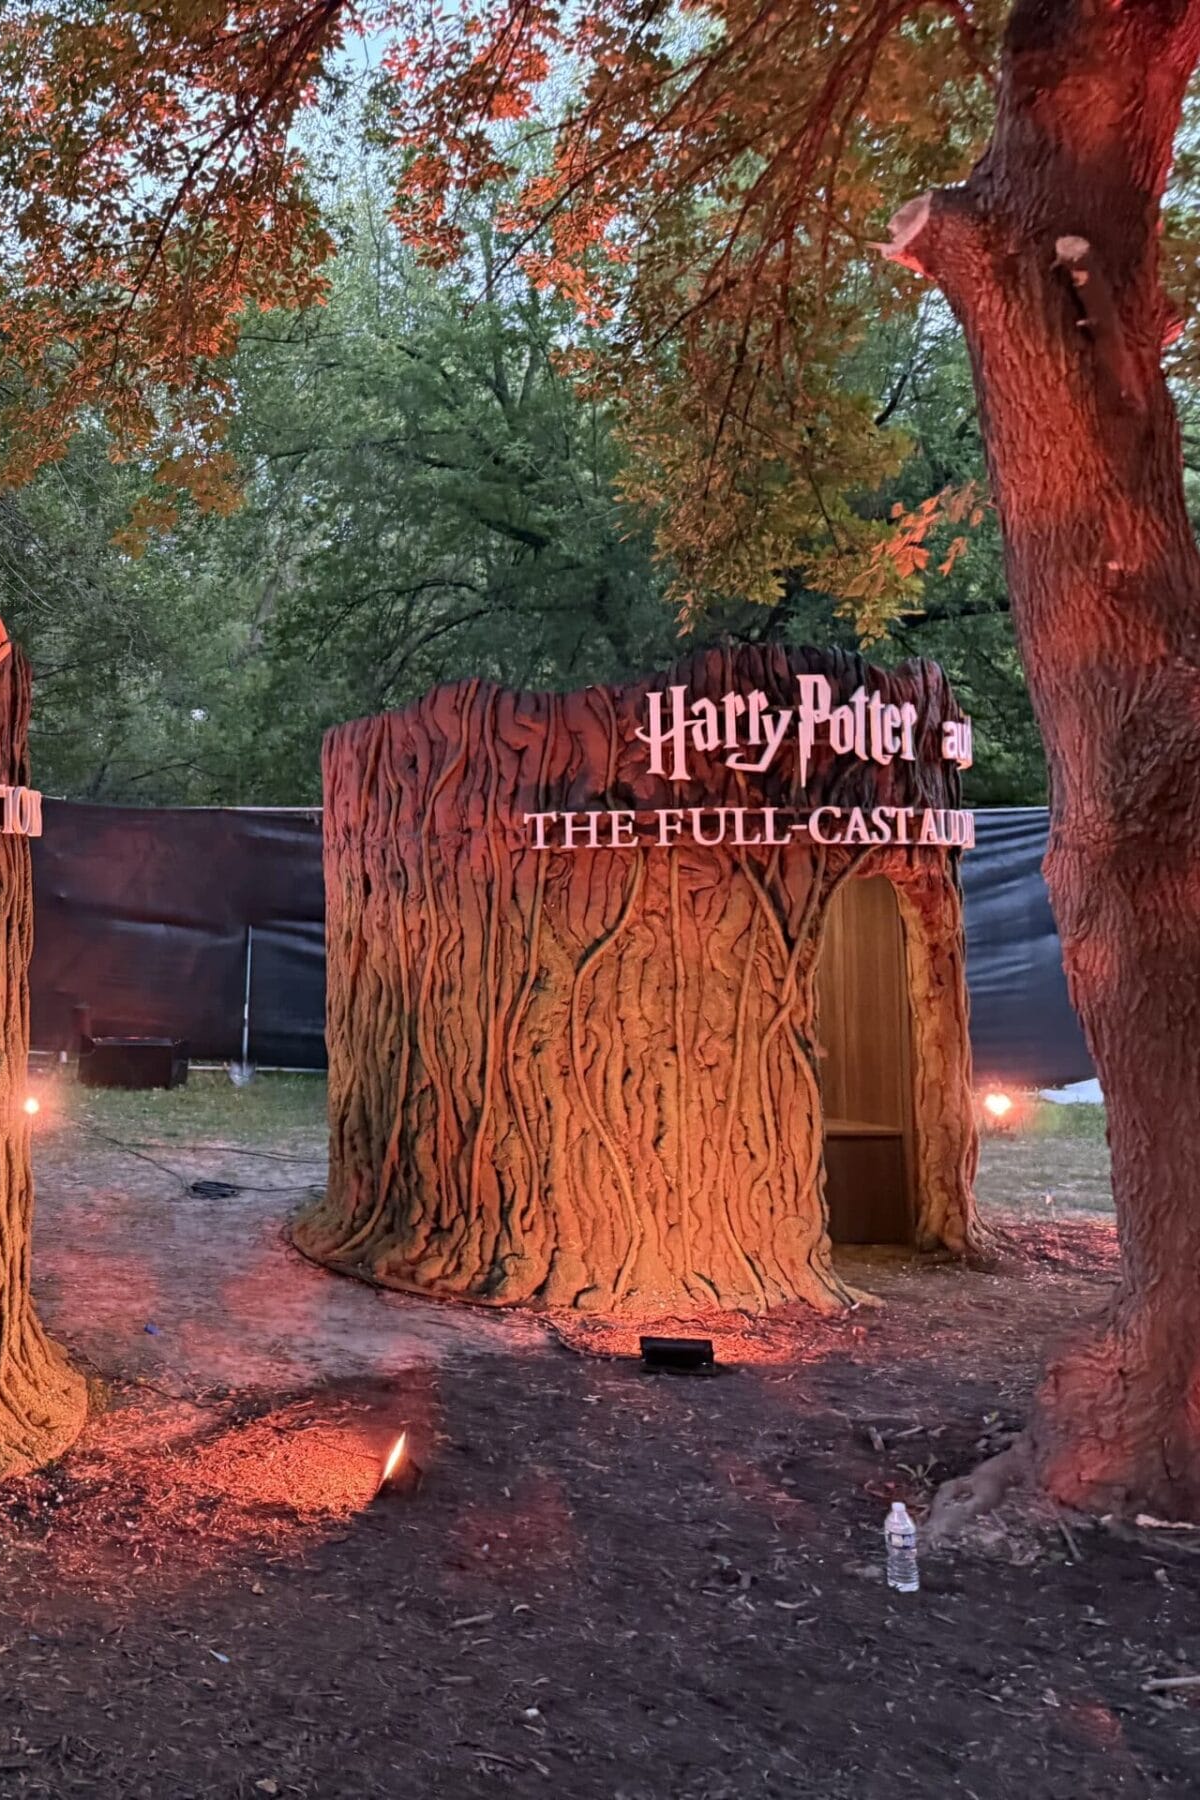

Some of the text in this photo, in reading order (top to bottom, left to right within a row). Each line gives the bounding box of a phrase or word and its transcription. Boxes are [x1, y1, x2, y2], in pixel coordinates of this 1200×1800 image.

[635, 674, 918, 788] Harry Potter
[523, 810, 636, 850] THE
[654, 806, 914, 848] FULL-CAST
